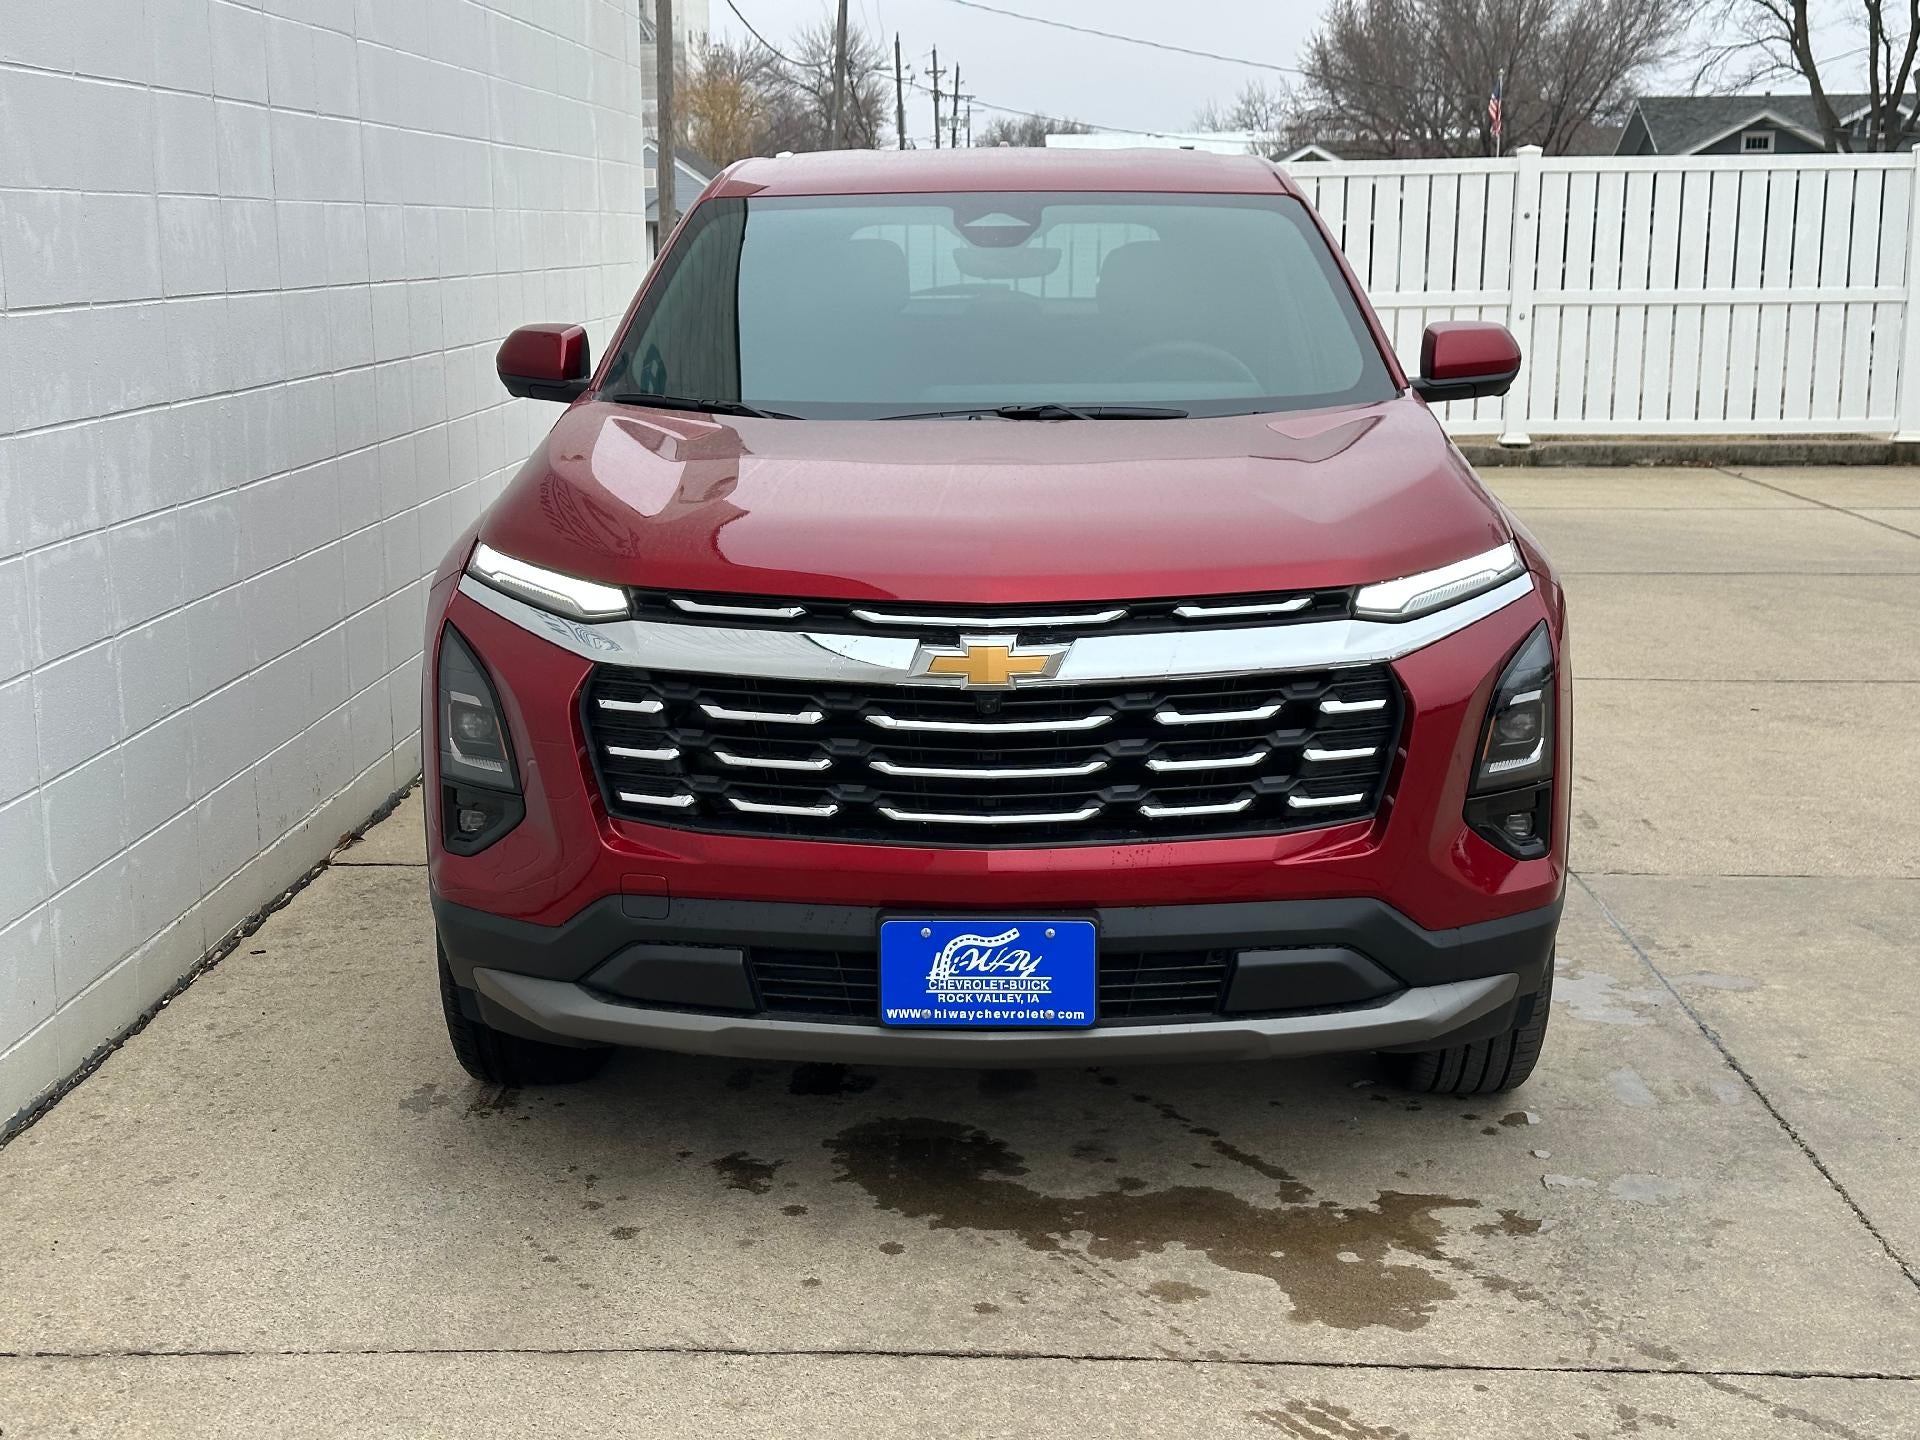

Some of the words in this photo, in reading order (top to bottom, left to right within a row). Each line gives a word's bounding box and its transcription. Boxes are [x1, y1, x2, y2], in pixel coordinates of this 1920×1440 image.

[928, 979, 1050, 990] CHEVROLET-BUICK
[937, 993, 974, 1003] ROCK
[975, 993, 1024, 1005] VALLEY,
[1027, 993, 1040, 1003] IA
